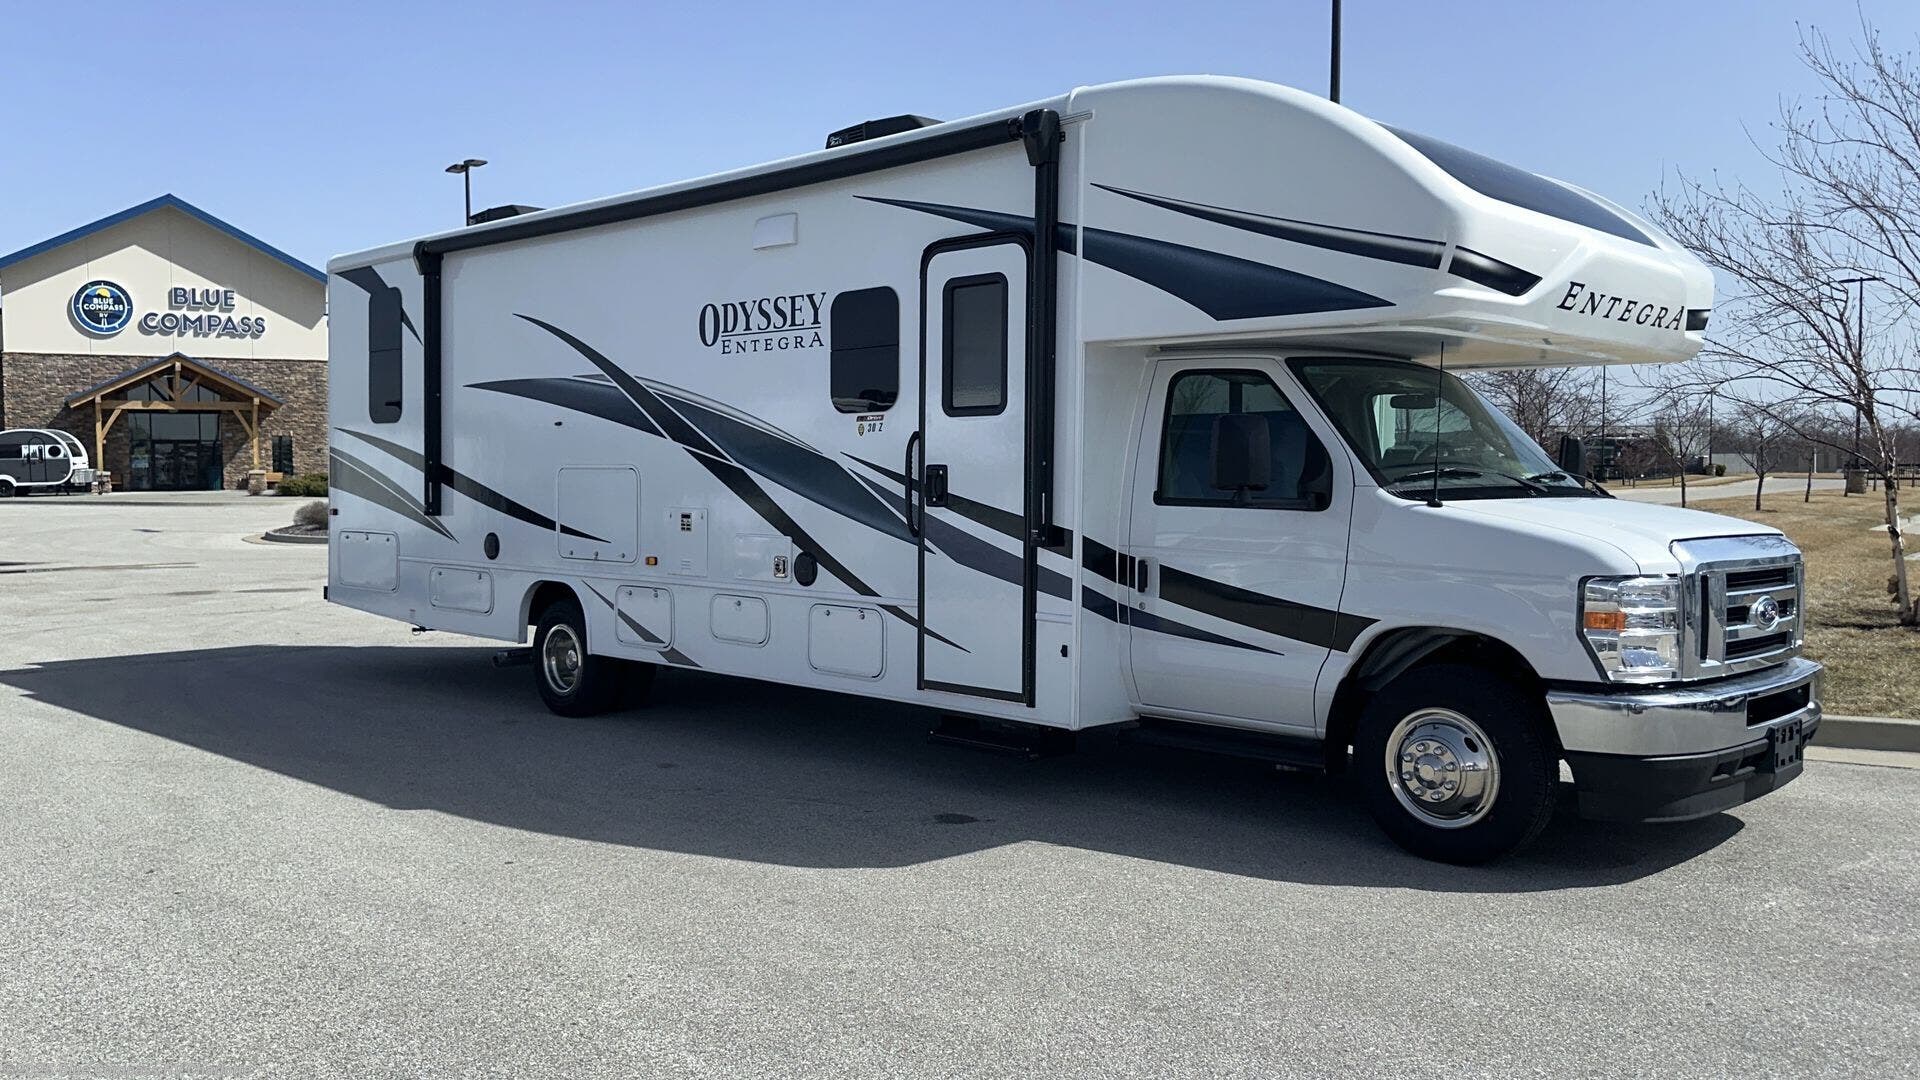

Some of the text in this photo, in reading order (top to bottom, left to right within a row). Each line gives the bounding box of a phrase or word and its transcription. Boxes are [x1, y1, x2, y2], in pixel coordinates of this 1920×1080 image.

[172, 287, 236, 307] BLUE
[1557, 281, 1685, 331] ENTEGRA
[141, 312, 267, 335] COMPASS
[699, 292, 826, 347] ODYSSEY
[721, 332, 825, 354] ENTEGRA
